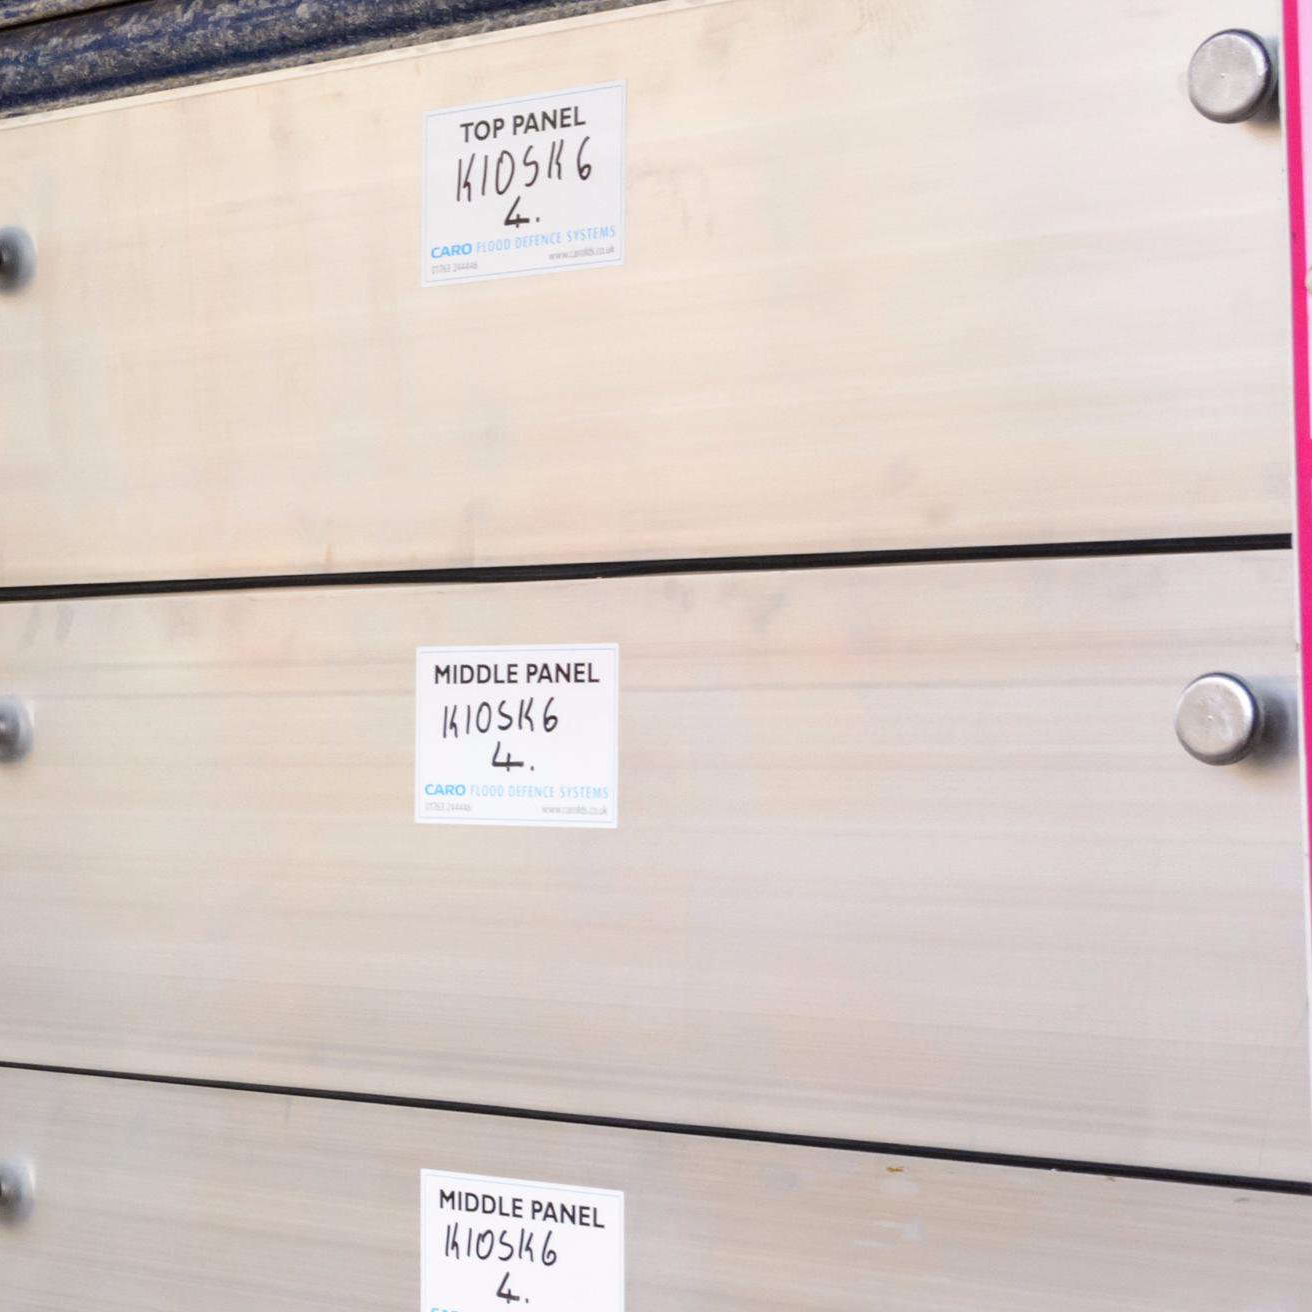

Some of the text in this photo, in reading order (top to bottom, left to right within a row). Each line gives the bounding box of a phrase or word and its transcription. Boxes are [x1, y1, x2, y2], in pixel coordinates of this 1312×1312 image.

[460, 106, 586, 143] TOP PANEL
[430, 226, 616, 259] CARO FLOOD DEFENCE SYSTEMS
[434, 663, 600, 684] MIDDLE PANEL
[425, 784, 608, 799] CARO FLOOD DEFENCE SYSTEMS
[439, 1189, 605, 1228] MIDDLE PANEL
